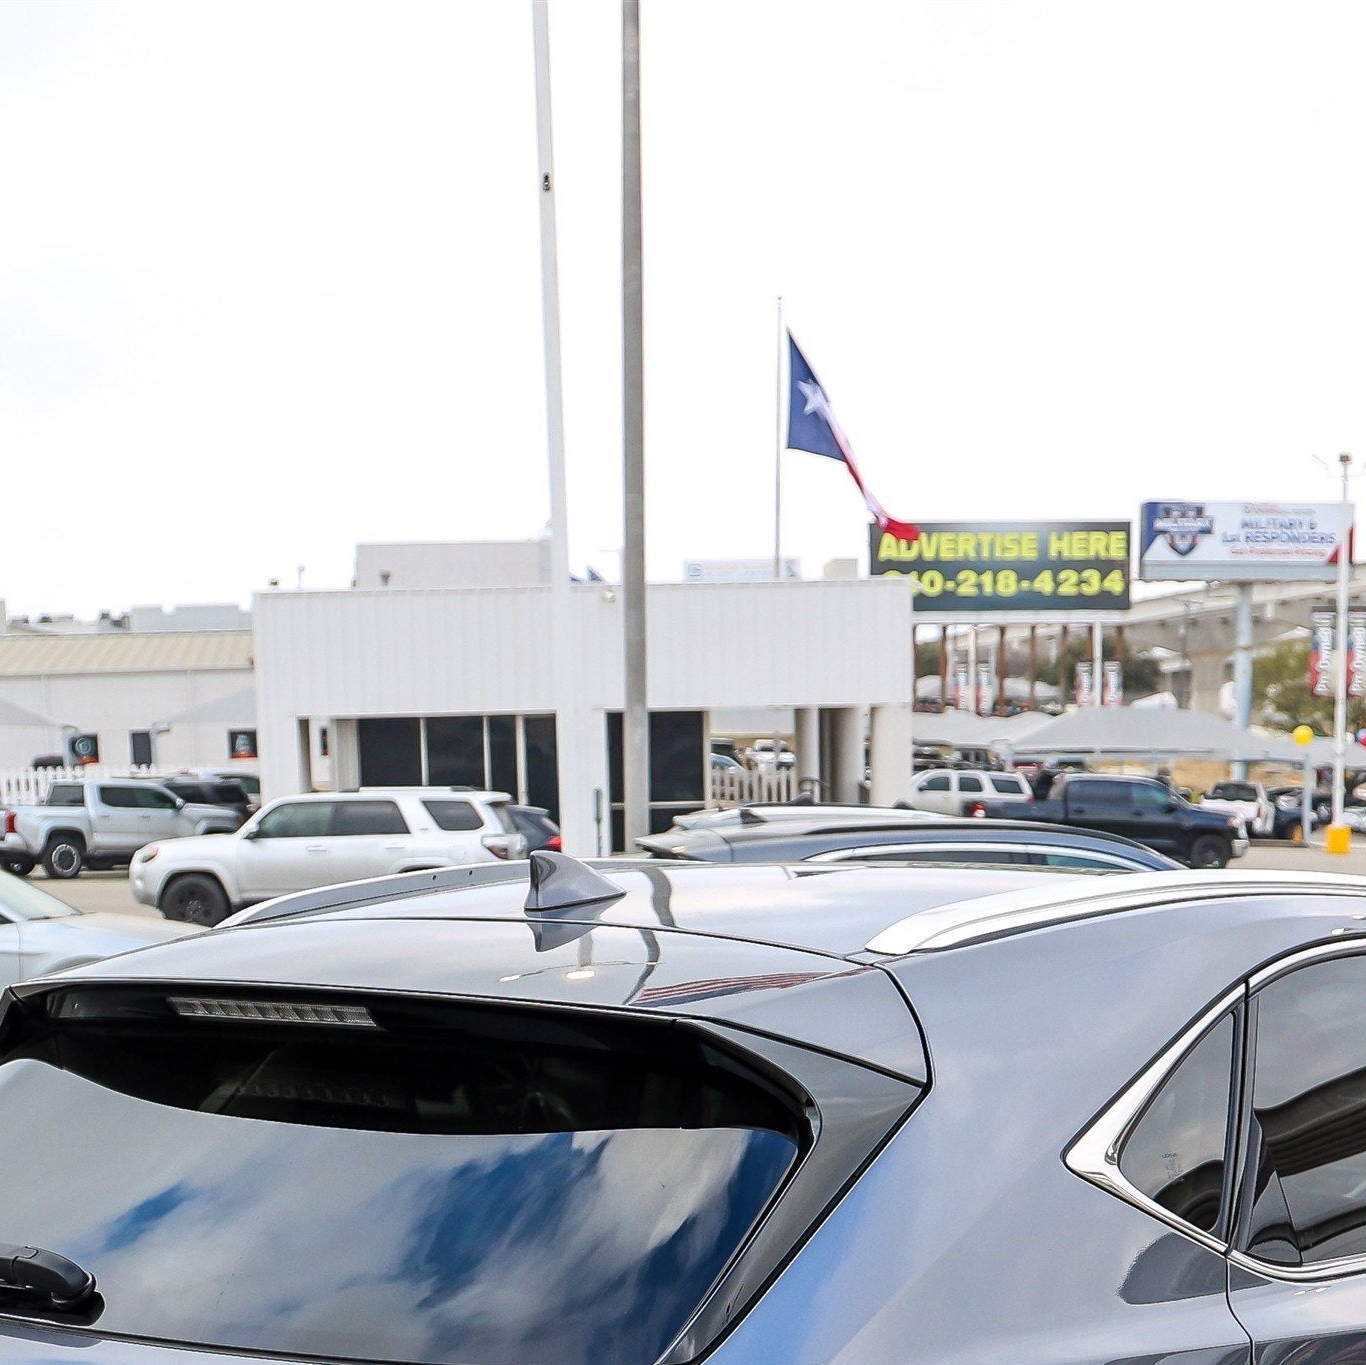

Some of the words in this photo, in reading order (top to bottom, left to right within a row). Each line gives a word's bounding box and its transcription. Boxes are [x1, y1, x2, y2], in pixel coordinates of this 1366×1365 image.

[878, 532, 1039, 562] ADVERTISE
[1049, 531, 1127, 561] HERE
[881, 568, 1126, 598] 10-218-4234
